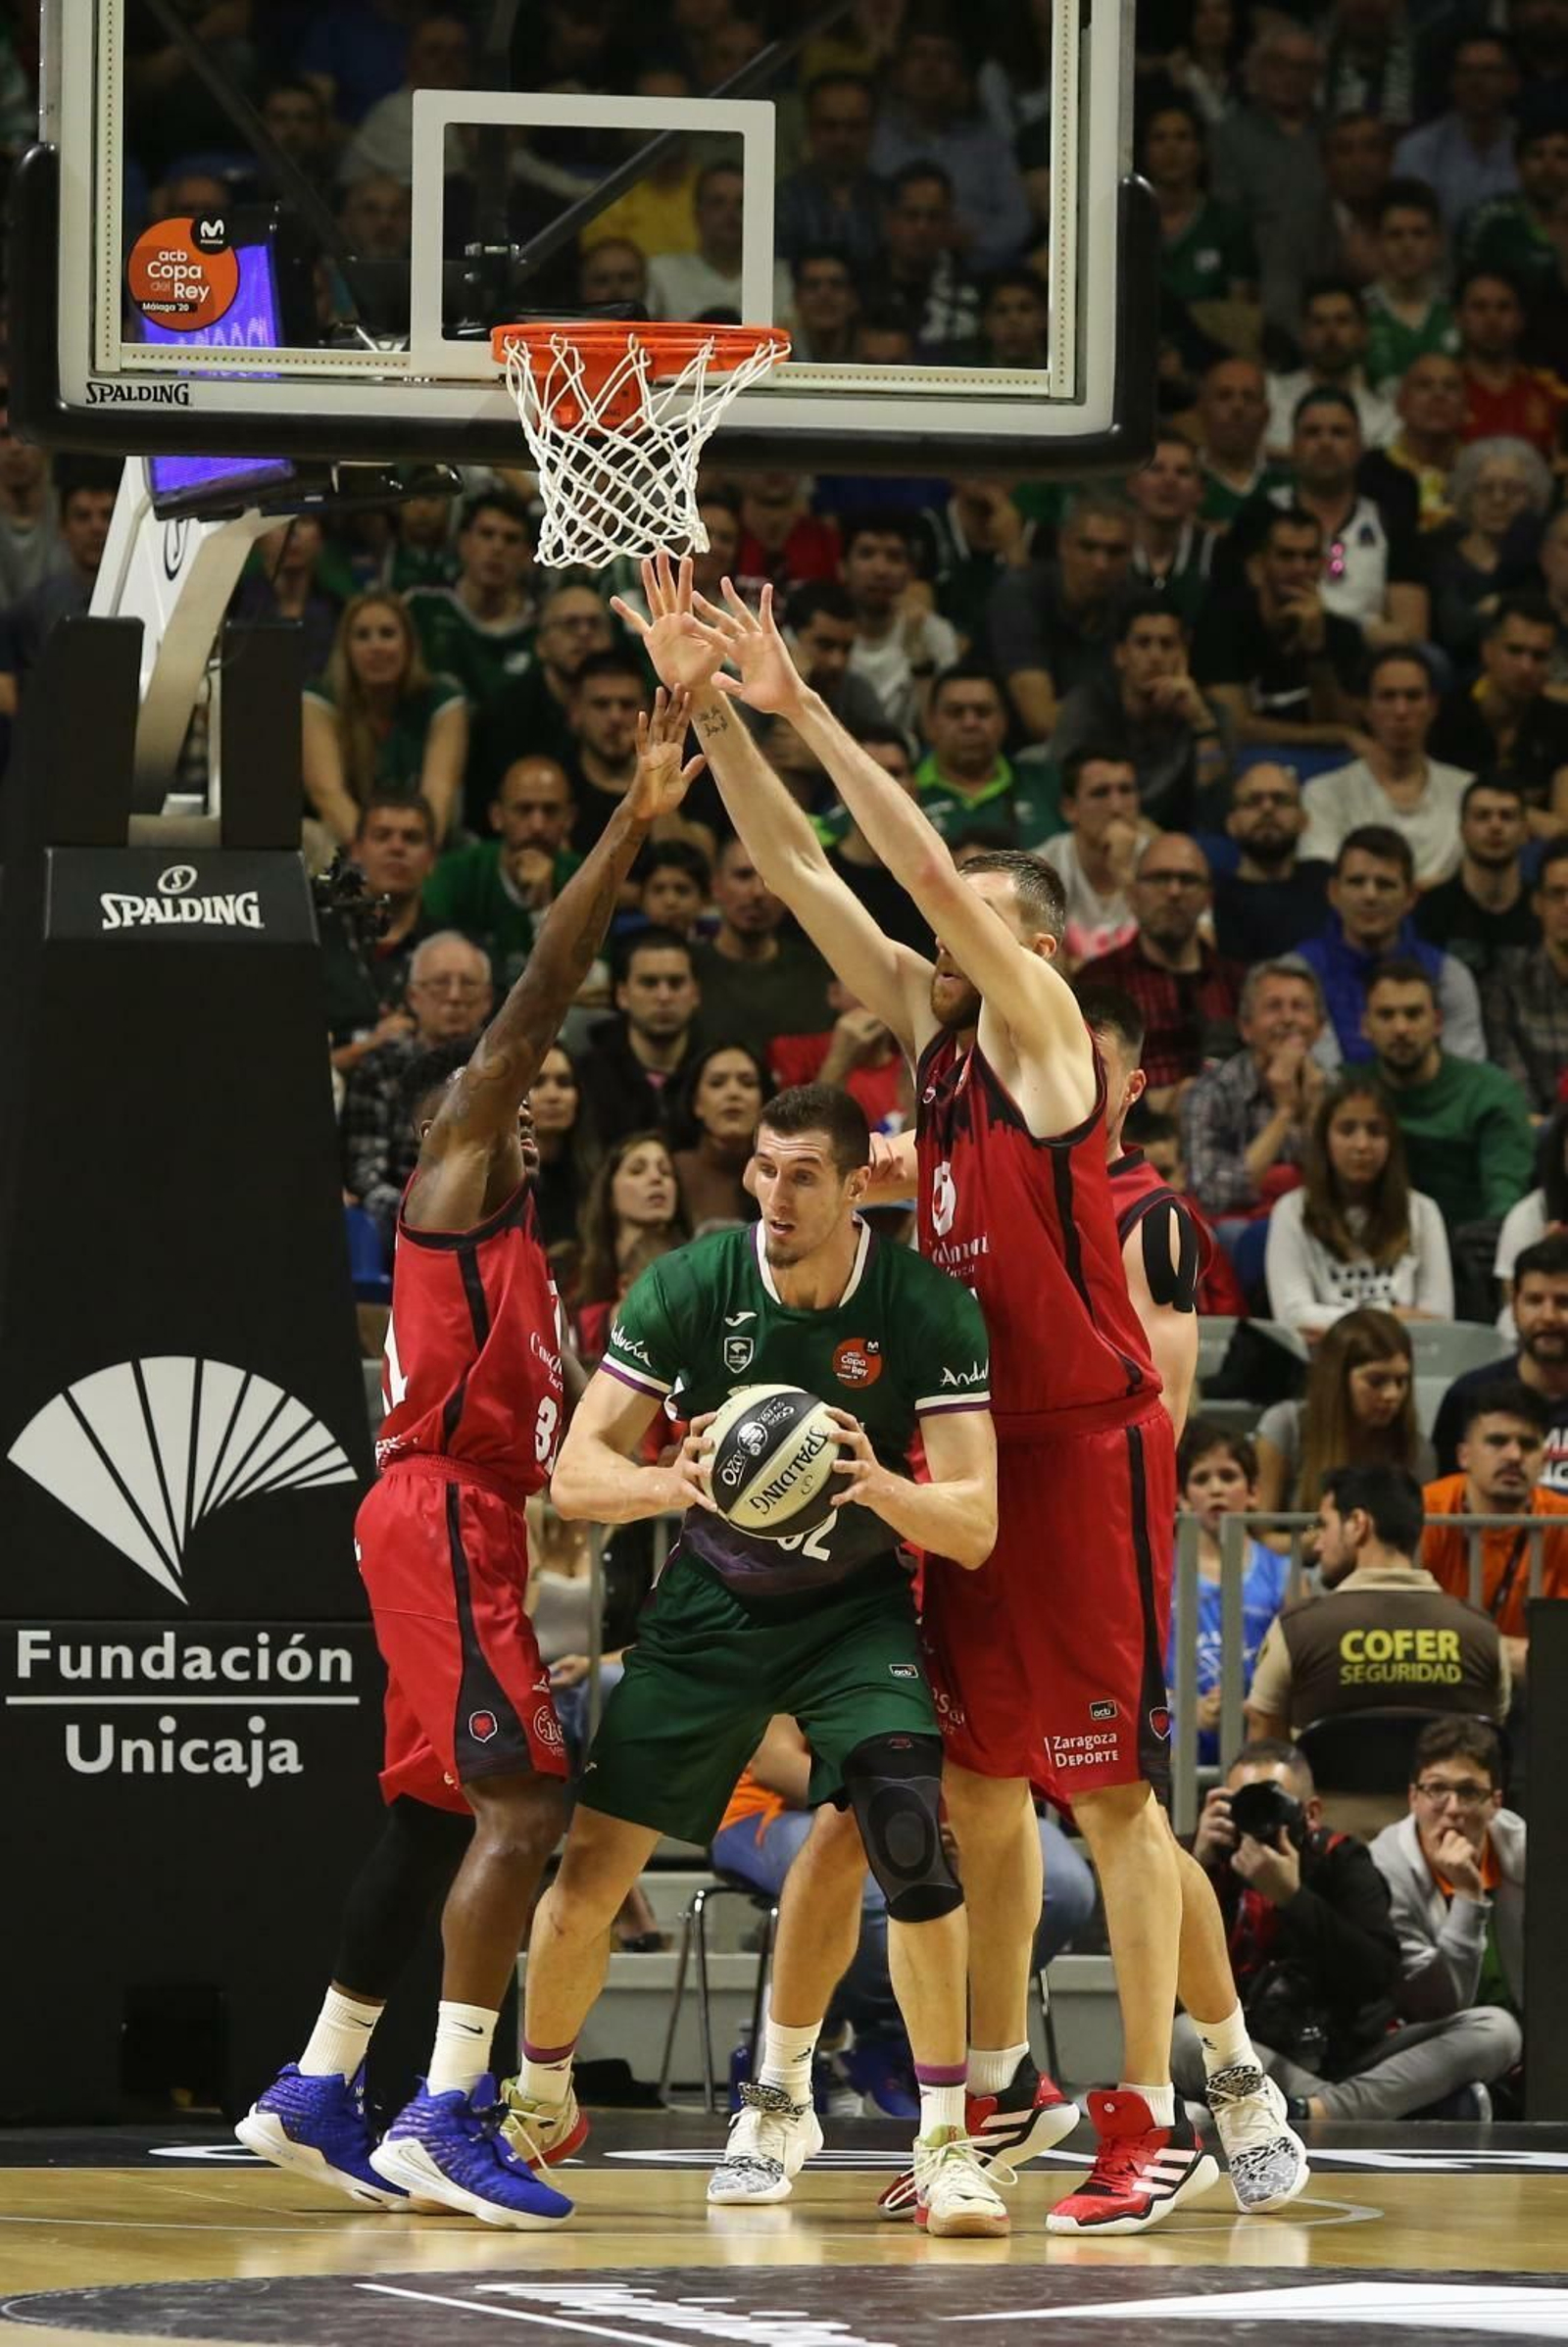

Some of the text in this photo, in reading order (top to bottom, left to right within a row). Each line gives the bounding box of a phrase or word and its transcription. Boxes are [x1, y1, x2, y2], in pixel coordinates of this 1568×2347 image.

[159, 250, 188, 262] acb
[147, 261, 202, 281] Copa
[174, 282, 211, 303] Rey
[85, 381, 190, 406] SPALDING
[100, 890, 261, 930] SPALDING
[749, 1425, 830, 1516] SPALDING
[18, 1630, 353, 1683] Fundación
[1340, 1629, 1461, 1662] COFER
[1340, 1664, 1463, 1686] SEGURIDAD
[65, 1715, 304, 1788] Unicaja
[1053, 1733, 1117, 1750] Zaragoza
[1054, 1749, 1119, 1768] DEPORTE
